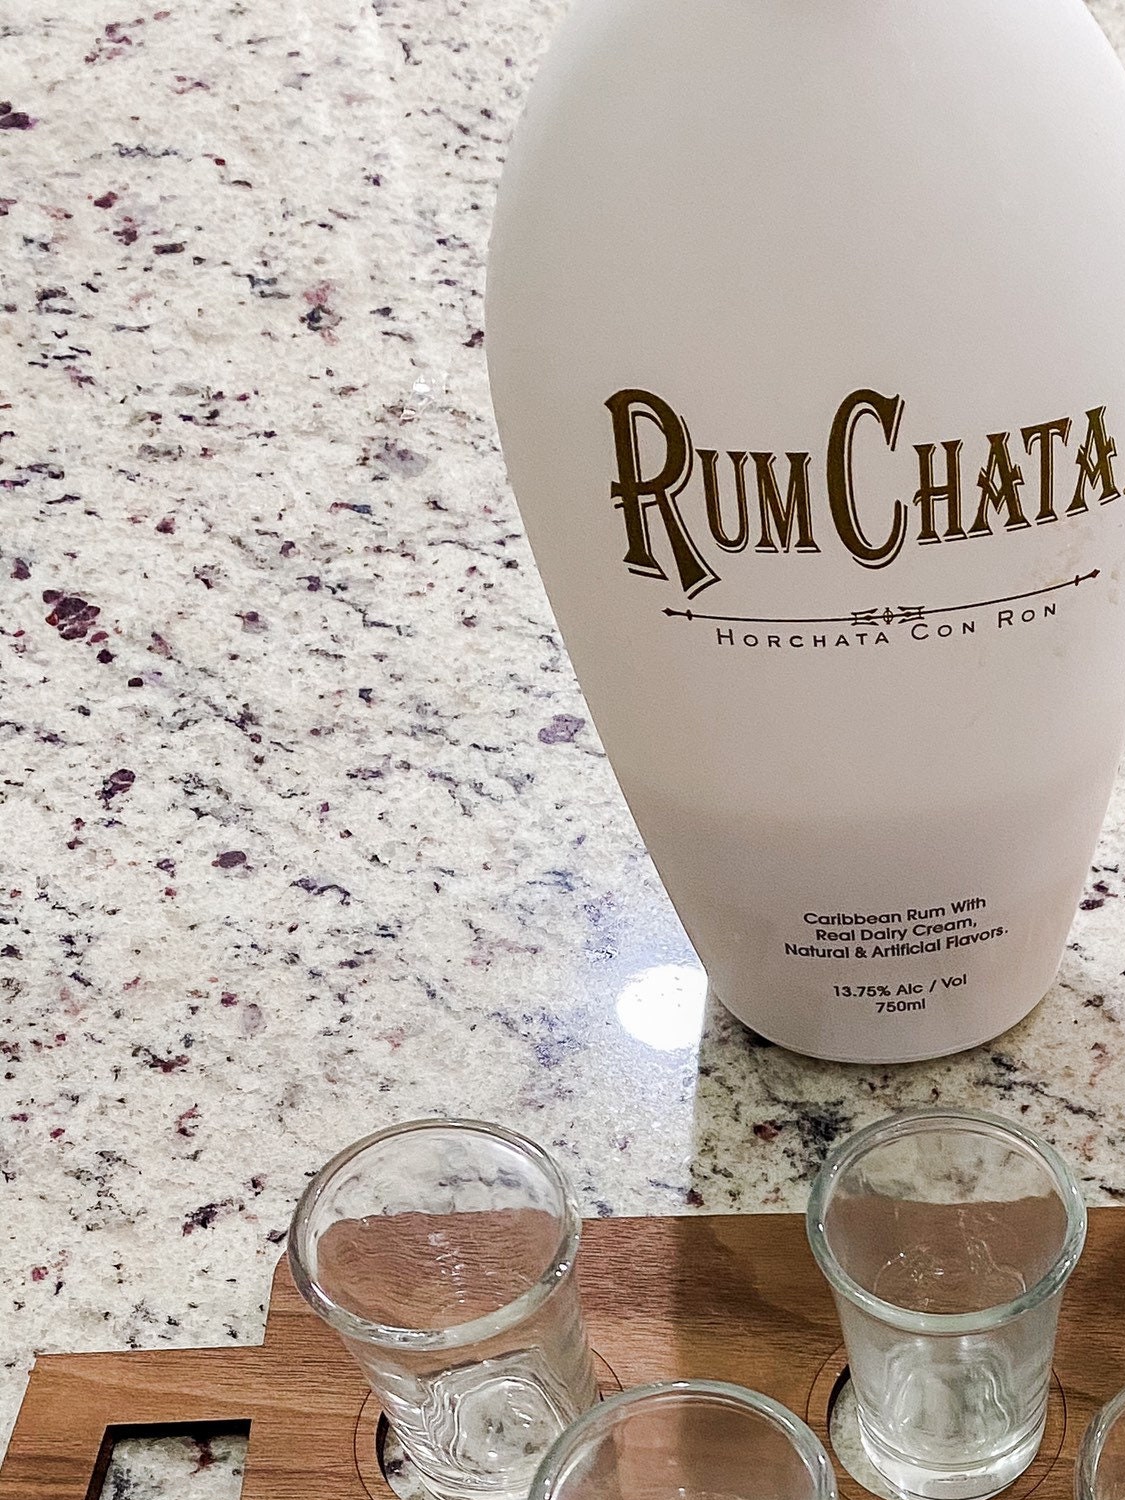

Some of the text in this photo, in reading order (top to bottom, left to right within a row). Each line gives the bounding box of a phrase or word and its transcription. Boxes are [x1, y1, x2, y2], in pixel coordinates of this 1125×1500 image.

[716, 602, 1058, 649] HORCHATA CON RON
[803, 897, 987, 926] Caribbean Rum With
[785, 925, 1009, 959] Natural & Artificial Flavors.
[815, 917, 977, 943] Real Dairy Cream,
[833, 974, 967, 998] 13.75% Alc / Vol
[875, 999, 926, 1013] 750ml
